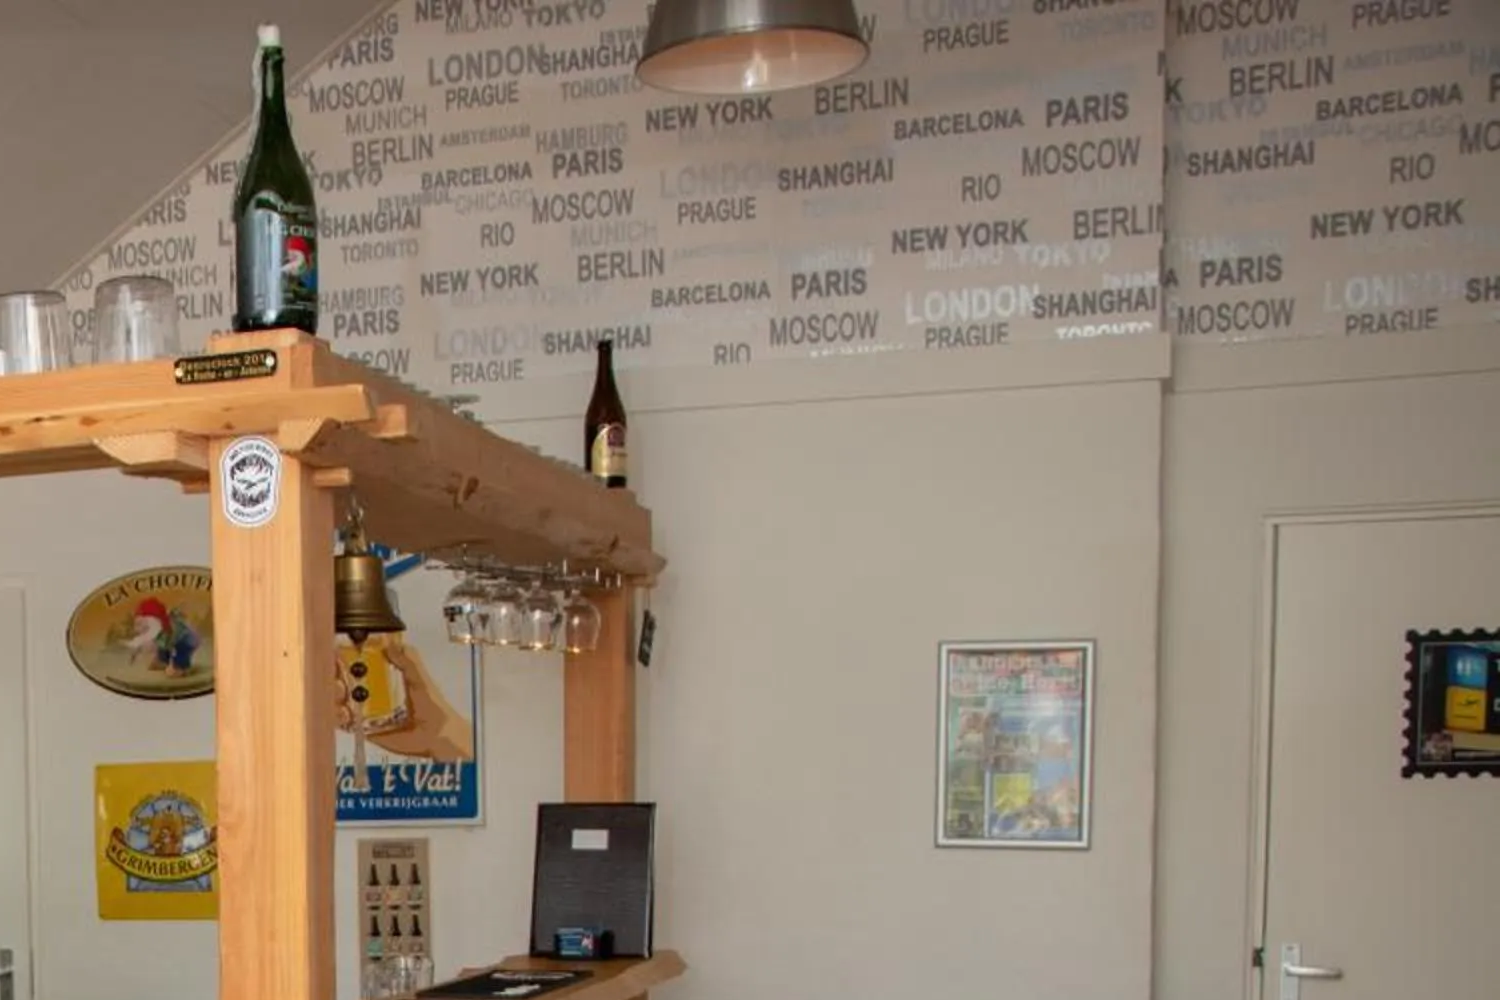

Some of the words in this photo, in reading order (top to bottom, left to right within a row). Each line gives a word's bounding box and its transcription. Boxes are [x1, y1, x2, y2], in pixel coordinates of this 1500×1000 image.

[445, 11, 513, 34] MILANO
[522, 0, 605, 28] TOKYO
[1177, 0, 1298, 36] MOSCOW
[1352, 0, 1451, 30] PRAGUE
[923, 20, 1009, 52] PRAGUE
[1222, 23, 1328, 60] MUNICH
[428, 45, 546, 87] LONDON
[539, 43, 643, 76] SHANGHA
[560, 74, 643, 102] TORONTO
[1229, 56, 1334, 98] BERLIN
[309, 76, 405, 114] MOSCOW
[445, 81, 519, 112] PRAGUE
[815, 77, 910, 116] BERLIN
[1046, 92, 1129, 128] PARIS
[1316, 83, 1463, 121] BARCELONA
[345, 104, 428, 137] MUNICH
[646, 103, 698, 132] NEW
[707, 97, 773, 126] YORK
[894, 108, 1025, 141] BARCELONA
[352, 133, 434, 169] BERLIN
[440, 124, 530, 148] AMSTERDAM
[536, 121, 628, 153] HAMBURG
[553, 148, 623, 179] PARIS
[1022, 136, 1141, 177] MOSCOW
[1187, 140, 1316, 177] SHANGHAI
[1391, 153, 1435, 184] RIO
[422, 161, 532, 192] BARCELONA
[778, 158, 894, 191] SHANGHAI
[962, 174, 1002, 203] RIO
[532, 188, 634, 224] MOSCOW
[678, 197, 756, 225] PRAGUE
[1310, 208, 1374, 239] NEW
[1383, 199, 1465, 232] YORK
[322, 207, 422, 239] SHANGHAI
[481, 221, 515, 248] RIO
[892, 226, 949, 254] NEW
[957, 218, 1029, 248] YORK
[108, 236, 197, 271] MOSCOW
[341, 238, 419, 264] TORONTO
[577, 249, 665, 283] BERLIN
[421, 269, 470, 296] NEW
[476, 263, 540, 292] YORK
[792, 268, 867, 300] PARIS
[1200, 254, 1282, 288] PARIS
[318, 285, 404, 313] HAMBURG
[652, 280, 771, 308] BARCELONA
[905, 284, 1039, 325] LONDON
[1032, 287, 1158, 319] SHANGHAI
[334, 309, 400, 339] PARIS
[770, 310, 880, 348] MOSCOW
[1177, 299, 1294, 335] MOSCOW
[1345, 307, 1438, 336] PRAGUE
[544, 325, 653, 355] SHANGHAI
[925, 323, 1009, 349] PRAGUE
[714, 343, 751, 365] RIO
[451, 358, 524, 385] PRAGUE
[104, 584, 130, 607] LA
[134, 573, 213, 593] CHOUF
[401, 757, 461, 792] Vat!
[359, 796, 459, 811] VERKRIJGBAAR
[115, 847, 218, 876] GRIMBERGEN
